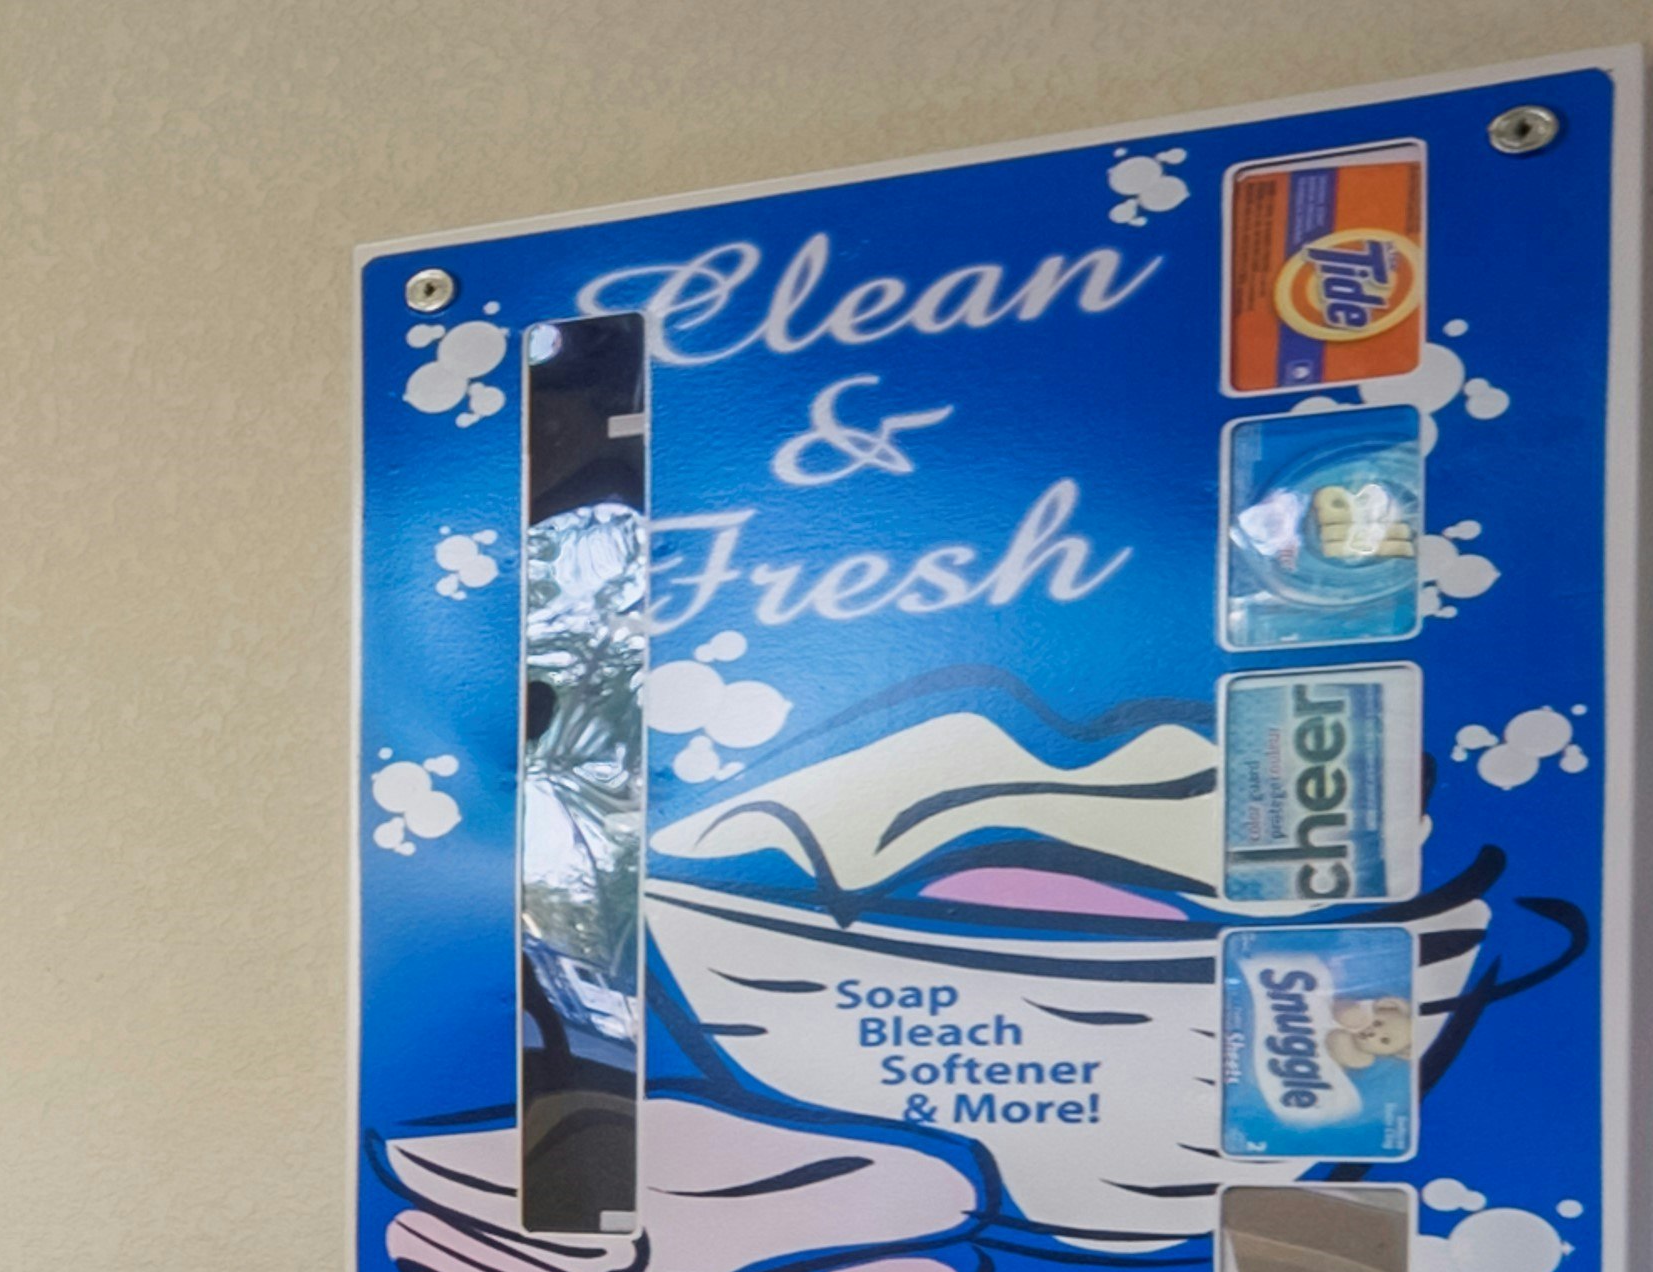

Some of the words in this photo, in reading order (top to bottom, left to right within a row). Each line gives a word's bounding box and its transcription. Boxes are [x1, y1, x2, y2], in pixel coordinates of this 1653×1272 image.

[575, 232, 1164, 367] Clean
[1305, 239, 1390, 328] Tide
[771, 373, 954, 486] &
[647, 477, 1134, 638] Fresh
[1226, 683, 1351, 899] cheer
[836, 979, 958, 1016] Soap
[859, 1015, 1022, 1047] Bleach
[1259, 969, 1332, 1109] Snuggle
[881, 1053, 1101, 1085] Softener
[903, 1093, 938, 1124] &
[954, 1093, 1100, 1124] More!
